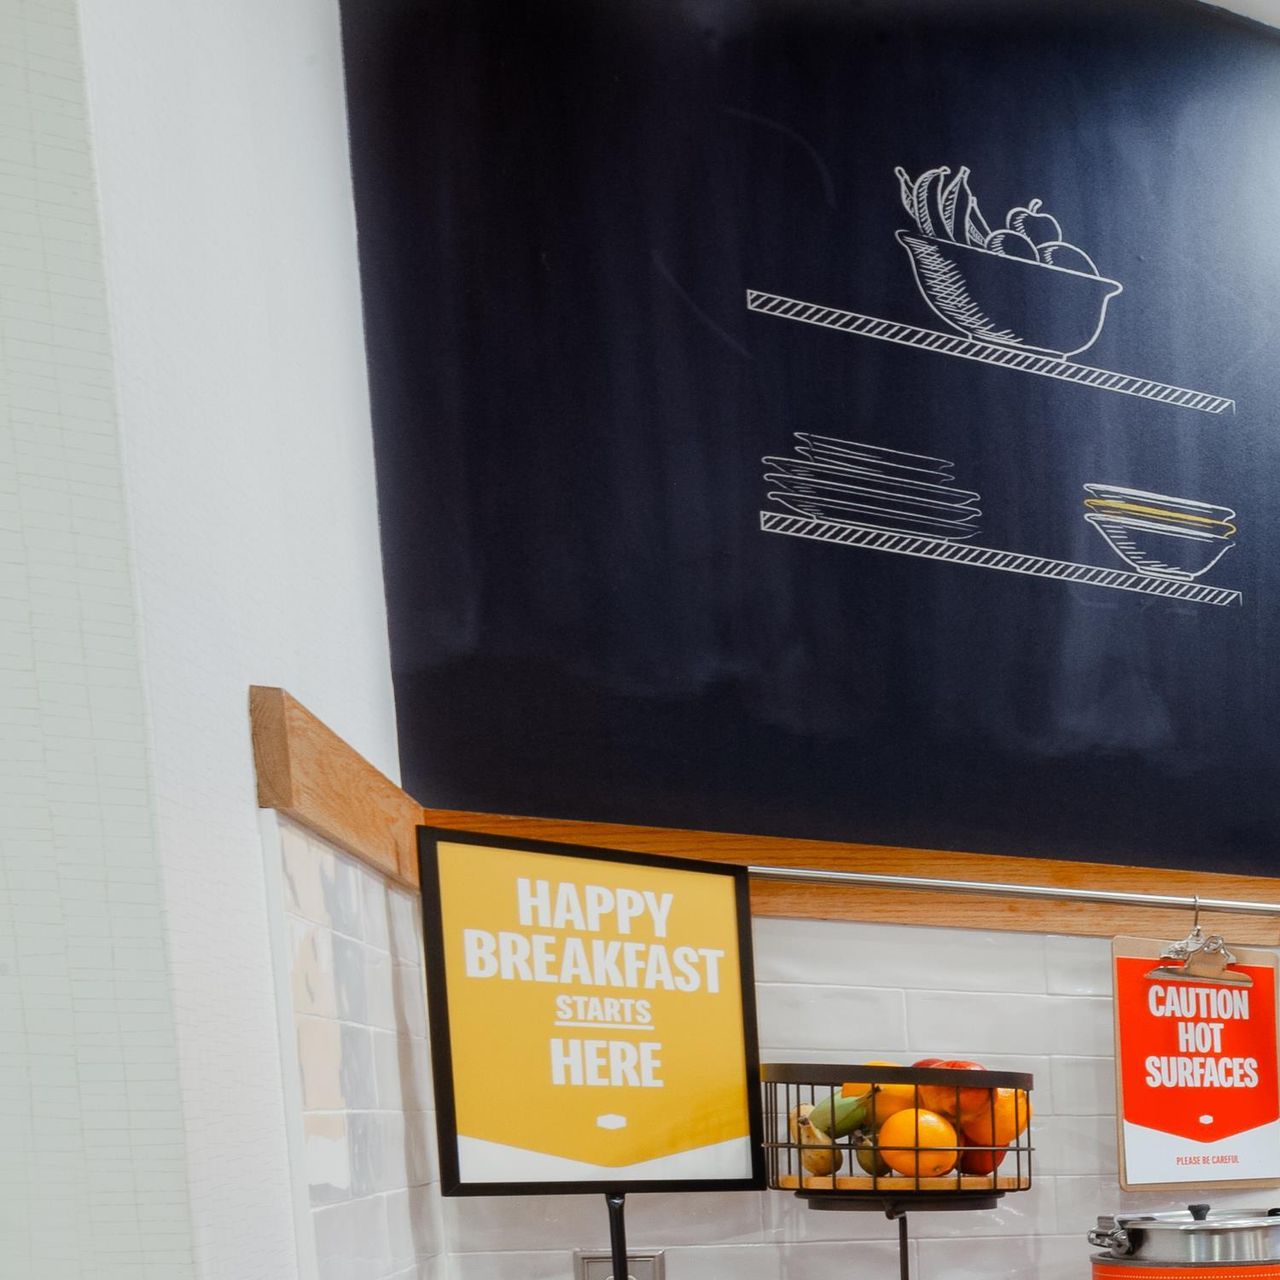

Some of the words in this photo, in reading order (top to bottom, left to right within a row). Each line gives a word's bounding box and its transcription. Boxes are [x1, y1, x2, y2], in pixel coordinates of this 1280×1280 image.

[516, 877, 674, 938] HAPPY
[463, 928, 726, 993] BREAKFAST
[555, 994, 653, 1024] STARTS
[1148, 984, 1250, 1020] CAUTION
[1178, 1021, 1224, 1053] HOT
[549, 1038, 665, 1088] HERE
[1145, 1055, 1259, 1088] SURFACES
[1176, 1156, 1201, 1166] PLEASE
[1202, 1155, 1210, 1164] BE
[1211, 1154, 1240, 1164] CAREFUL
